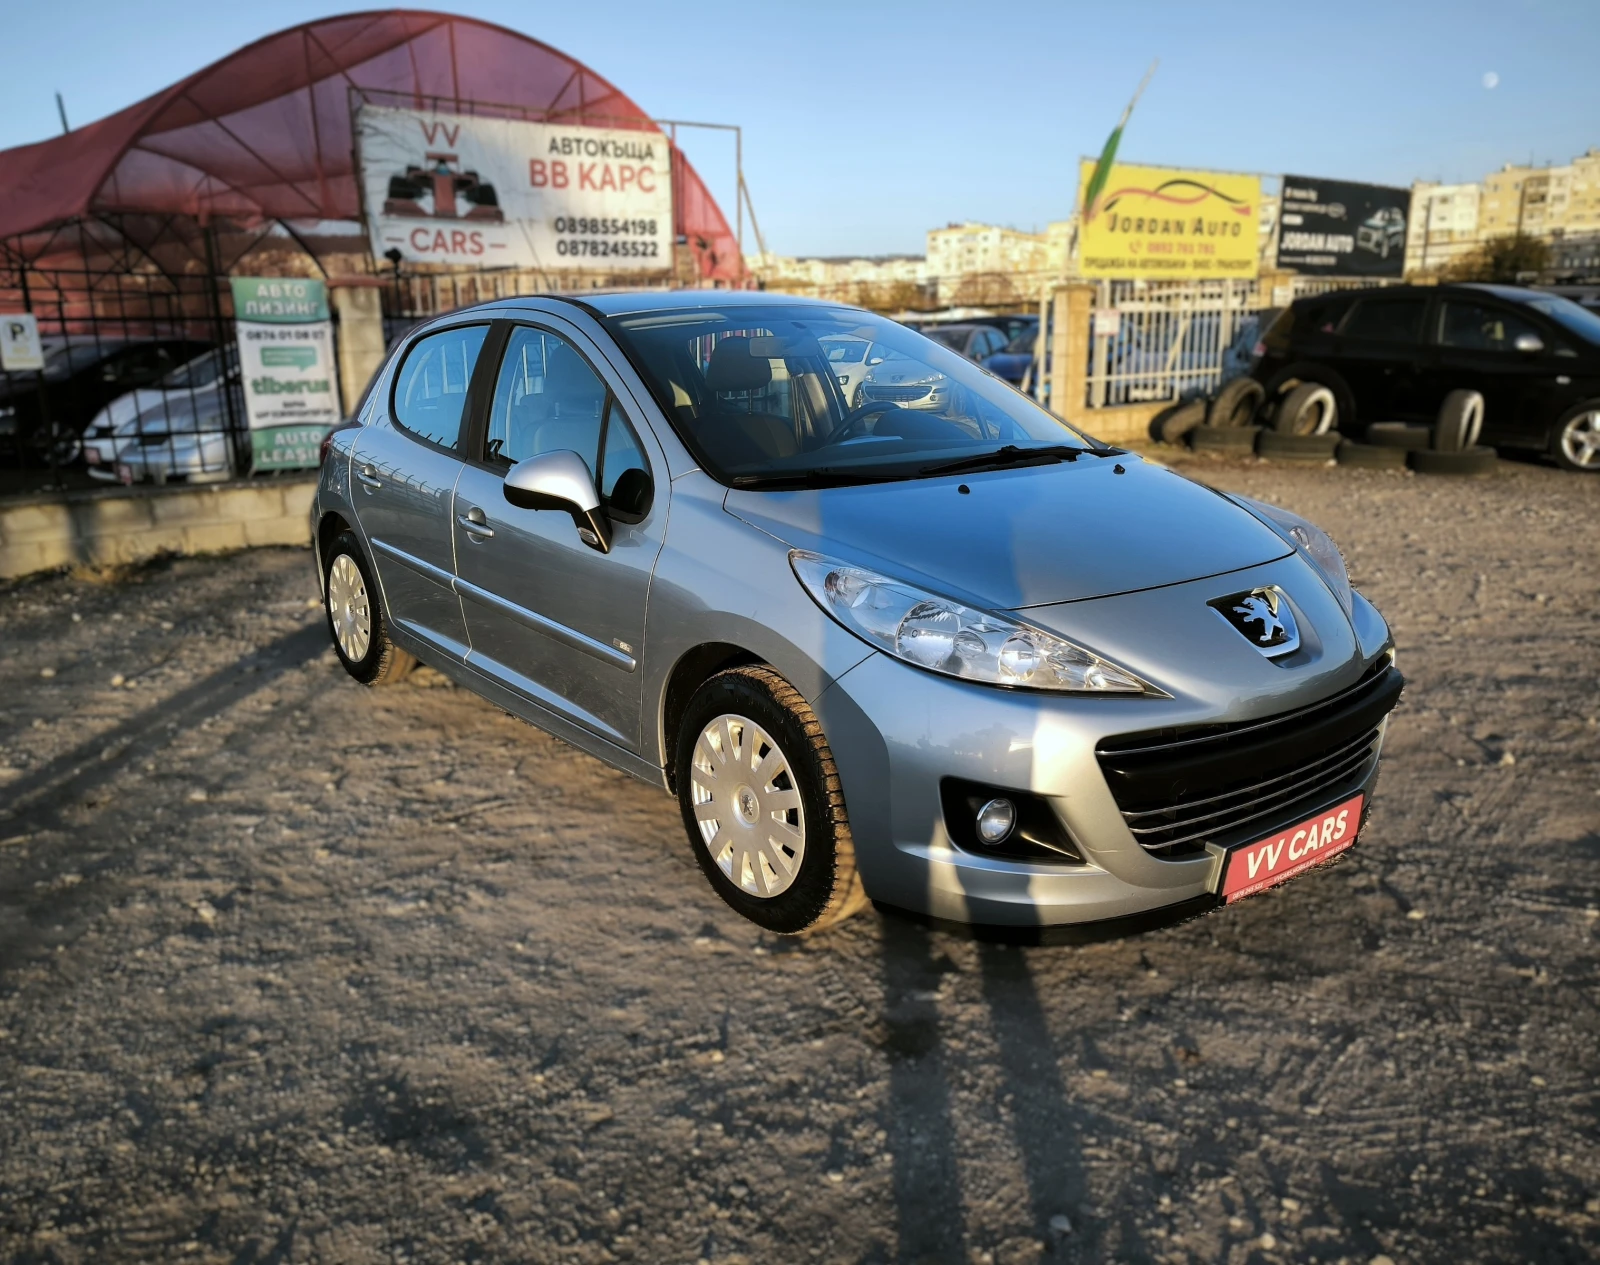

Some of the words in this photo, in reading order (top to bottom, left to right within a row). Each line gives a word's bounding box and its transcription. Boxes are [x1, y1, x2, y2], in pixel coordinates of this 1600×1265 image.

[420, 120, 461, 148] VV
[548, 136, 655, 160] АВТОКЪЩА
[528, 158, 570, 190] ВВ
[578, 161, 657, 193] КАРС
[554, 216, 658, 237] 0898554198
[1108, 212, 1185, 236] JORDAN
[1192, 216, 1242, 238] AUTO
[409, 227, 486, 256] CARS
[556, 239, 659, 258] 0878245522
[256, 283, 306, 298] АВТО
[245, 300, 318, 316] ЛИЗИНГ
[251, 376, 331, 396] tiberus
[274, 431, 323, 447] AUTO
[260, 447, 320, 463] LEASI
[1246, 838, 1286, 879] VV
[1288, 809, 1349, 862] CARS
